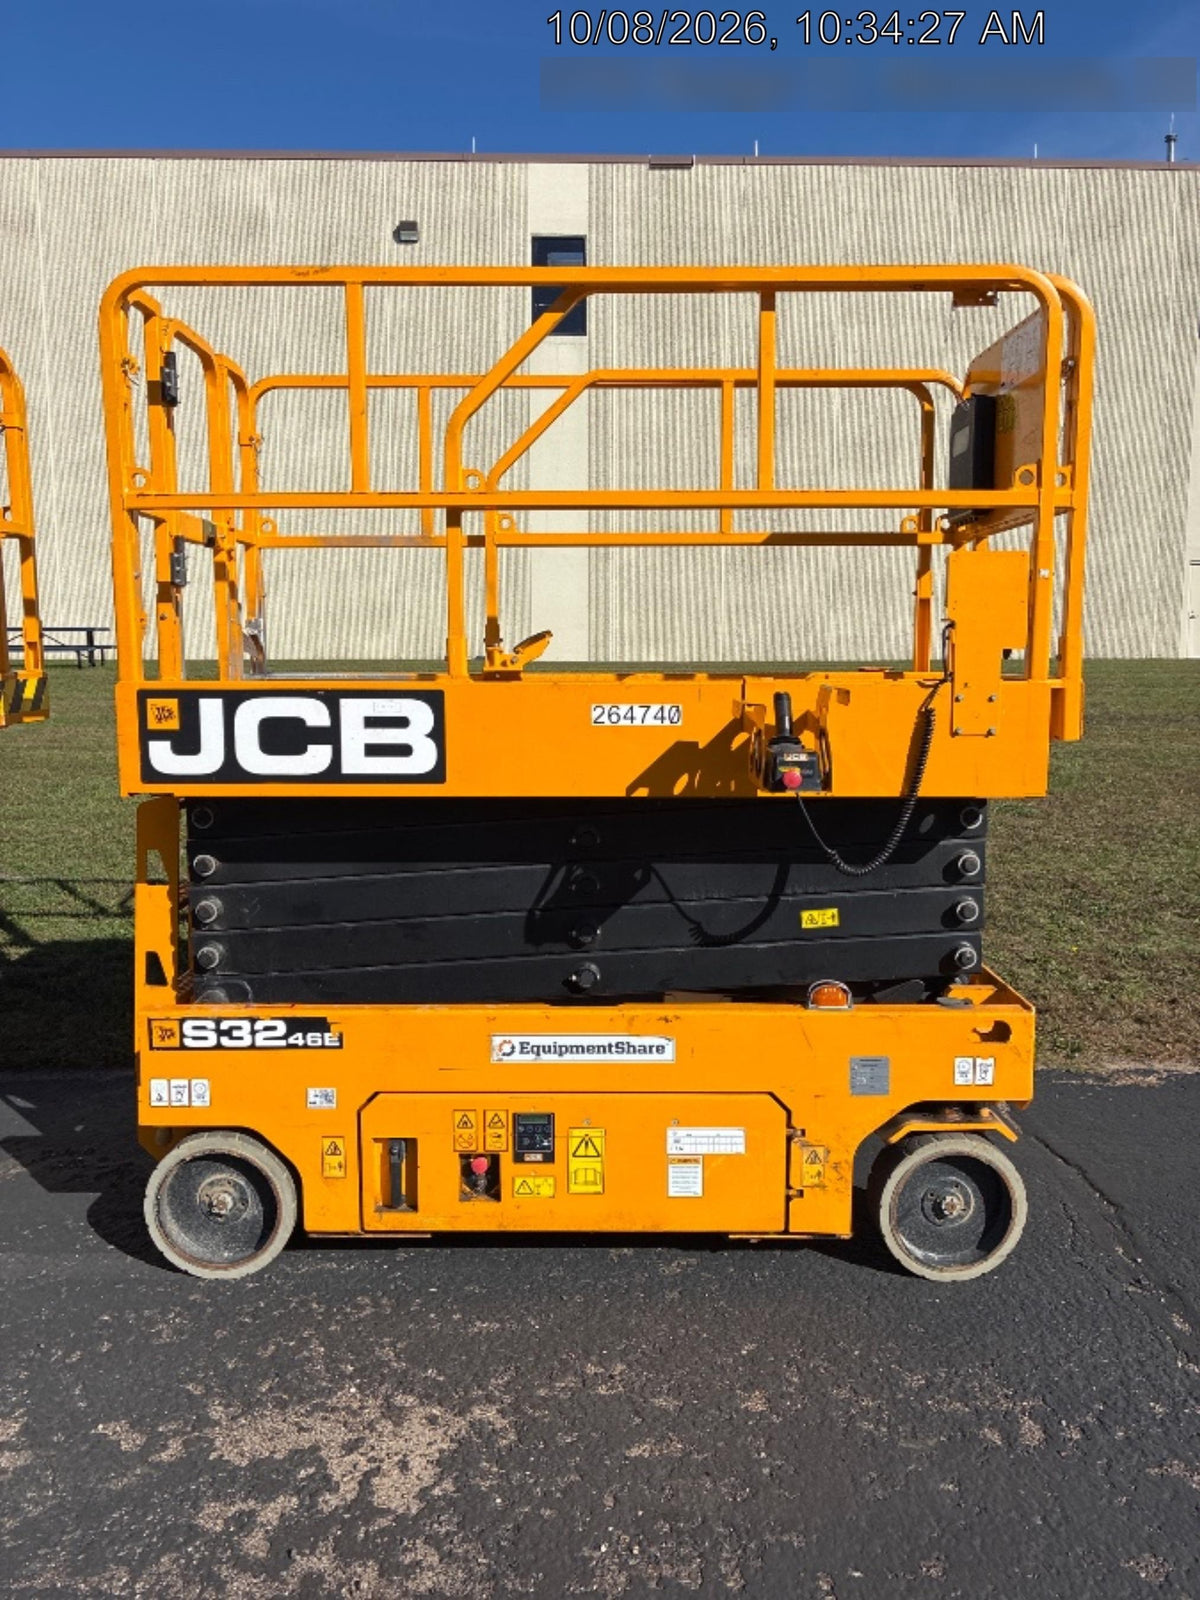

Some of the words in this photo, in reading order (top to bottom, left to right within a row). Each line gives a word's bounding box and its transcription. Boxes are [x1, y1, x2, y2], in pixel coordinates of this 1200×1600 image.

[593, 705, 681, 724] 264740
[147, 696, 439, 776] JCB
[518, 1041, 666, 1058] EquipmentShare
